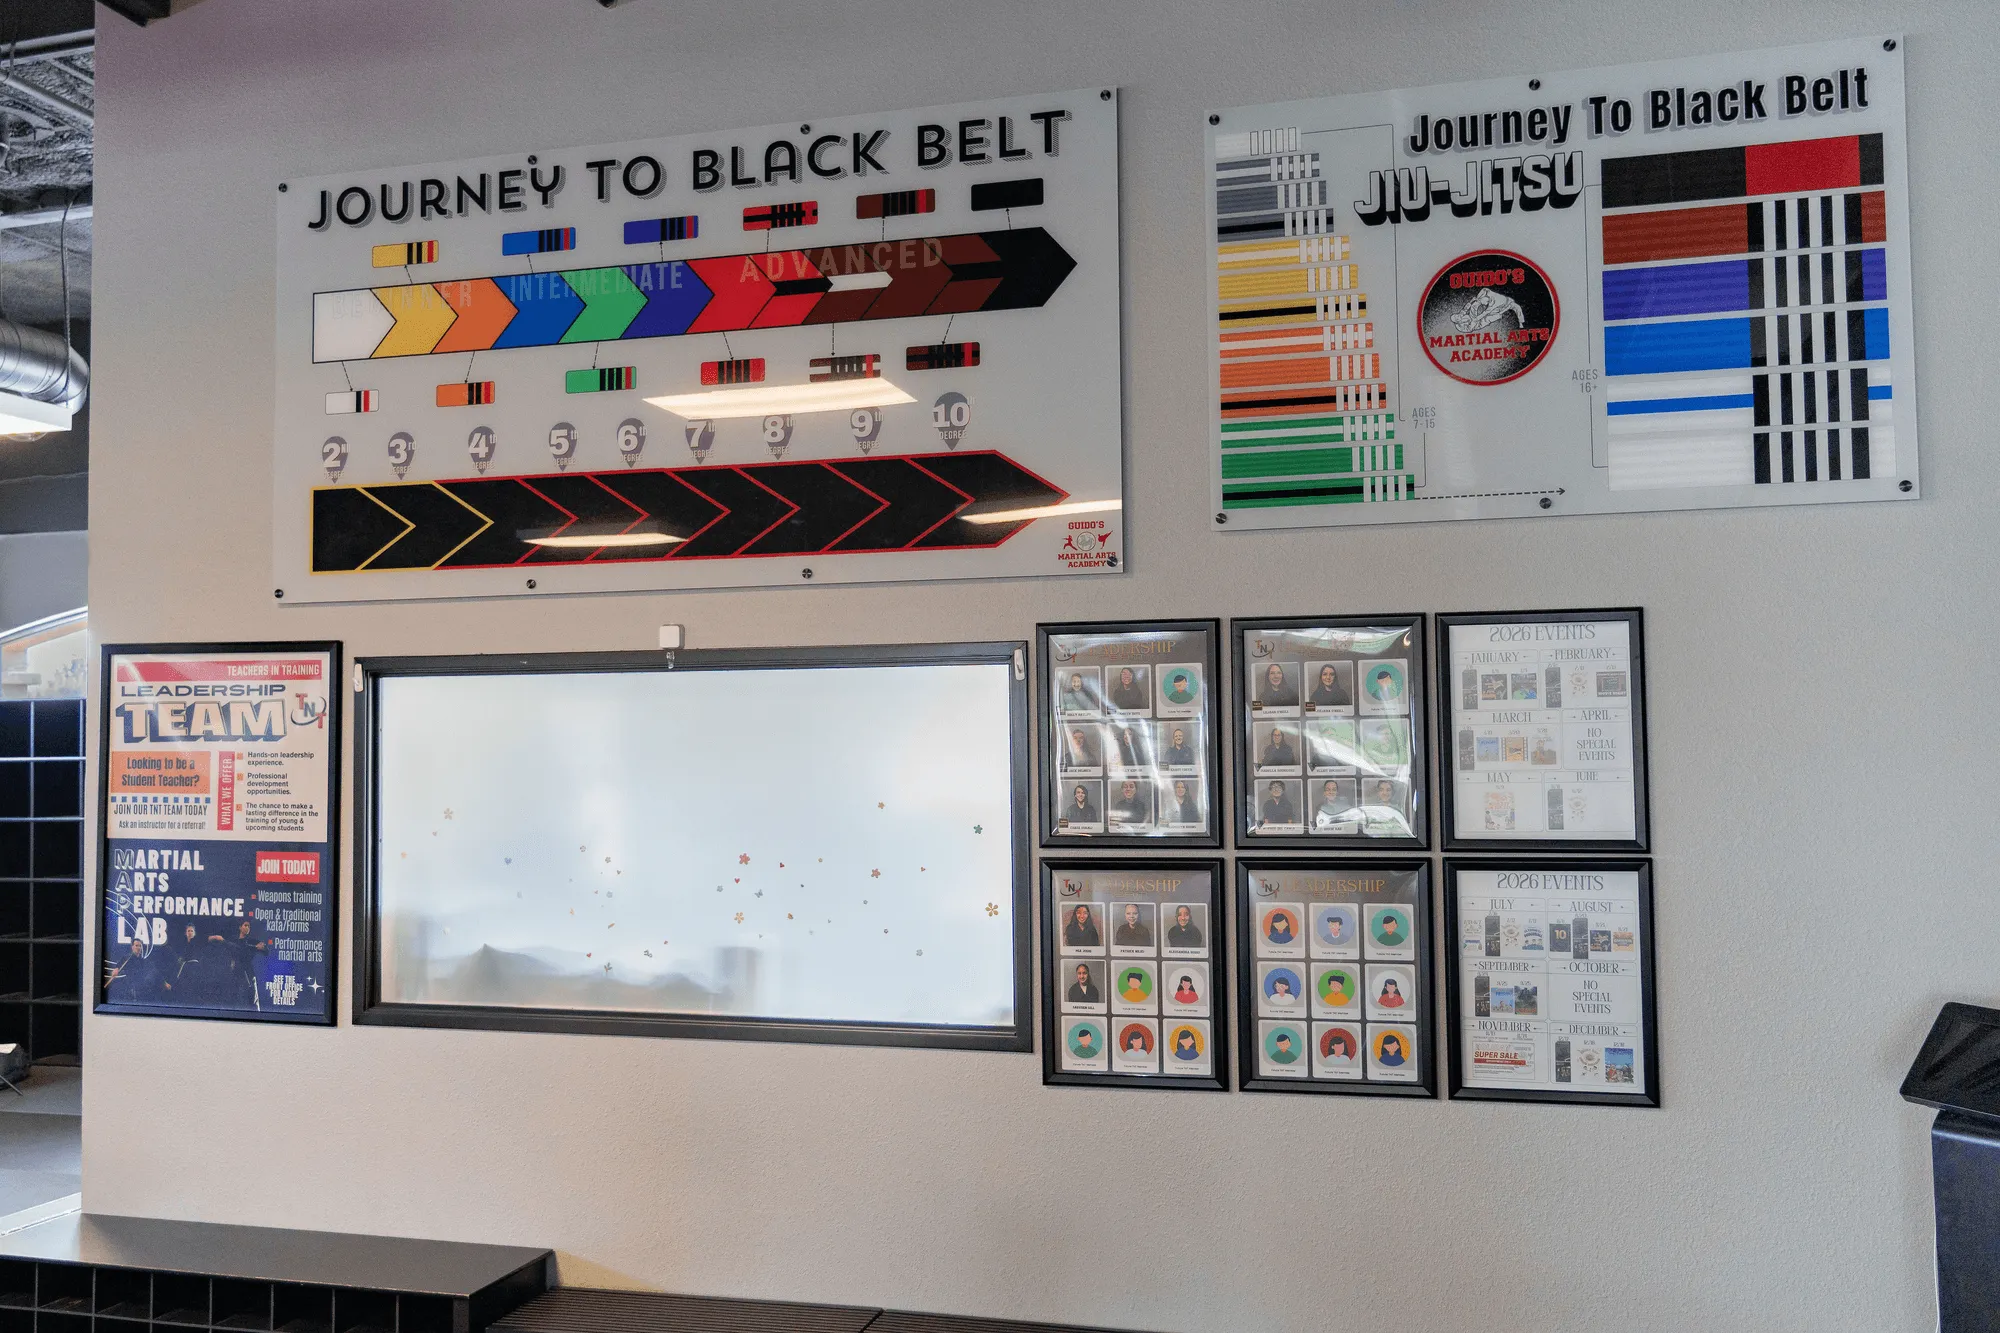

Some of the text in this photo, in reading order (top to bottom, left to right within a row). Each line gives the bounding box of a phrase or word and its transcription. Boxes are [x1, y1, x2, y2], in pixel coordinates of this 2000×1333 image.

[1405, 67, 1869, 155] Journey To Black Belt
[307, 109, 1072, 232] JOURNEY TO BLACK BELT
[1353, 150, 1584, 226] JIU-JITSU
[739, 237, 944, 284] ADVANCED
[510, 261, 684, 302] INTERMEDIATE
[1449, 267, 1525, 289] GUIDO'S
[1430, 327, 1550, 348] MARTIAL ARTS
[1450, 345, 1530, 363] ACADEMY
[1572, 369, 1598, 381] AGES
[1579, 382, 1598, 393] 16+
[1412, 407, 1436, 418] AGES
[763, 415, 796, 443] 8th
[850, 410, 885, 438] 9th
[1413, 418, 1436, 429] 7-15
[617, 424, 647, 452] 6th
[686, 420, 717, 448] 7th
[939, 429, 968, 440] DEGREE
[469, 432, 498, 459] 4th
[549, 428, 578, 456] 5th
[854, 441, 881, 451] DEGREE
[690, 449, 715, 458] DEGREE
[764, 445, 791, 455] DEGREE
[552, 457, 576, 466] DEGREE
[620, 453, 644, 462] DEGREE
[1068, 520, 1105, 530] GUIDO'S
[1057, 551, 1116, 560] MARTIAL ARTS
[1068, 560, 1106, 568] ACADEMY
[1490, 624, 1596, 642] 2026 EVENTS
[1083, 640, 1176, 656] EADERSHIP
[1555, 648, 1612, 660] FEBRUARY
[1471, 652, 1520, 664] JANUARY
[227, 664, 320, 676] TEACHERS IN TRAINING
[121, 684, 286, 697] LEADERSHIP
[295, 693, 327, 729] TNT
[1580, 710, 1612, 720] APRIL
[116, 699, 287, 743] TEAM
[1492, 712, 1531, 723] MARCH
[1587, 728, 1602, 738] NO
[1576, 739, 1616, 749] SPECIAL
[247, 751, 315, 760] Hands-on leadership
[1578, 751, 1616, 761] EVENTS
[127, 757, 196, 771] Looking to be a
[121, 774, 200, 788] Student Teacher?
[1487, 772, 1512, 783] MAY
[1576, 771, 1599, 781] JUNE
[247, 780, 289, 788] development
[221, 758, 233, 825] WHAT WE OFFER
[247, 788, 292, 796] opportunities.
[113, 804, 208, 816] JOIN OUR TNT TEAM TODAY
[246, 810, 267, 818] lasting
[118, 820, 129, 829] Ask
[138, 820, 167, 829] instructor
[167, 820, 175, 829] for
[181, 820, 206, 830] referral!
[246, 817, 270, 825] training
[279, 818, 298, 826] young
[245, 825, 275, 833] upcoming
[114, 849, 204, 871] MARTIAL
[258, 860, 316, 875] JOIN TODAY!
[115, 871, 169, 893] ARTS
[1085, 878, 1182, 893] LADERSHIP
[1283, 877, 1386, 893] LEADERSHIP
[1497, 873, 1604, 891] 2026 EVENTS
[258, 890, 322, 905] Weapons training
[117, 894, 245, 917] PERFORMANCE
[1490, 899, 1515, 911] JULY
[1569, 901, 1613, 913] AUGUST
[255, 908, 322, 922] Open & traditional
[117, 917, 168, 945] LAB
[1555, 929, 1567, 940] 10
[274, 938, 323, 951] Performance
[278, 949, 323, 962] martial arts
[1478, 961, 1529, 972] SEPTEMBER
[1569, 962, 1619, 974] OCTOBER
[273, 975, 296, 983] SEE THE
[1583, 980, 1598, 990] NO
[266, 982, 303, 991] FRONT OFFICE
[282, 990, 299, 998] MORE
[1572, 992, 1613, 1002] SPECIAL
[273, 997, 296, 1006] DETAILS
[1574, 1004, 1611, 1014] EVENTS
[1478, 1021, 1531, 1032] NOVEMBER
[1569, 1024, 1619, 1036] DECEMBER
[1499, 1052, 1519, 1060] SALE
